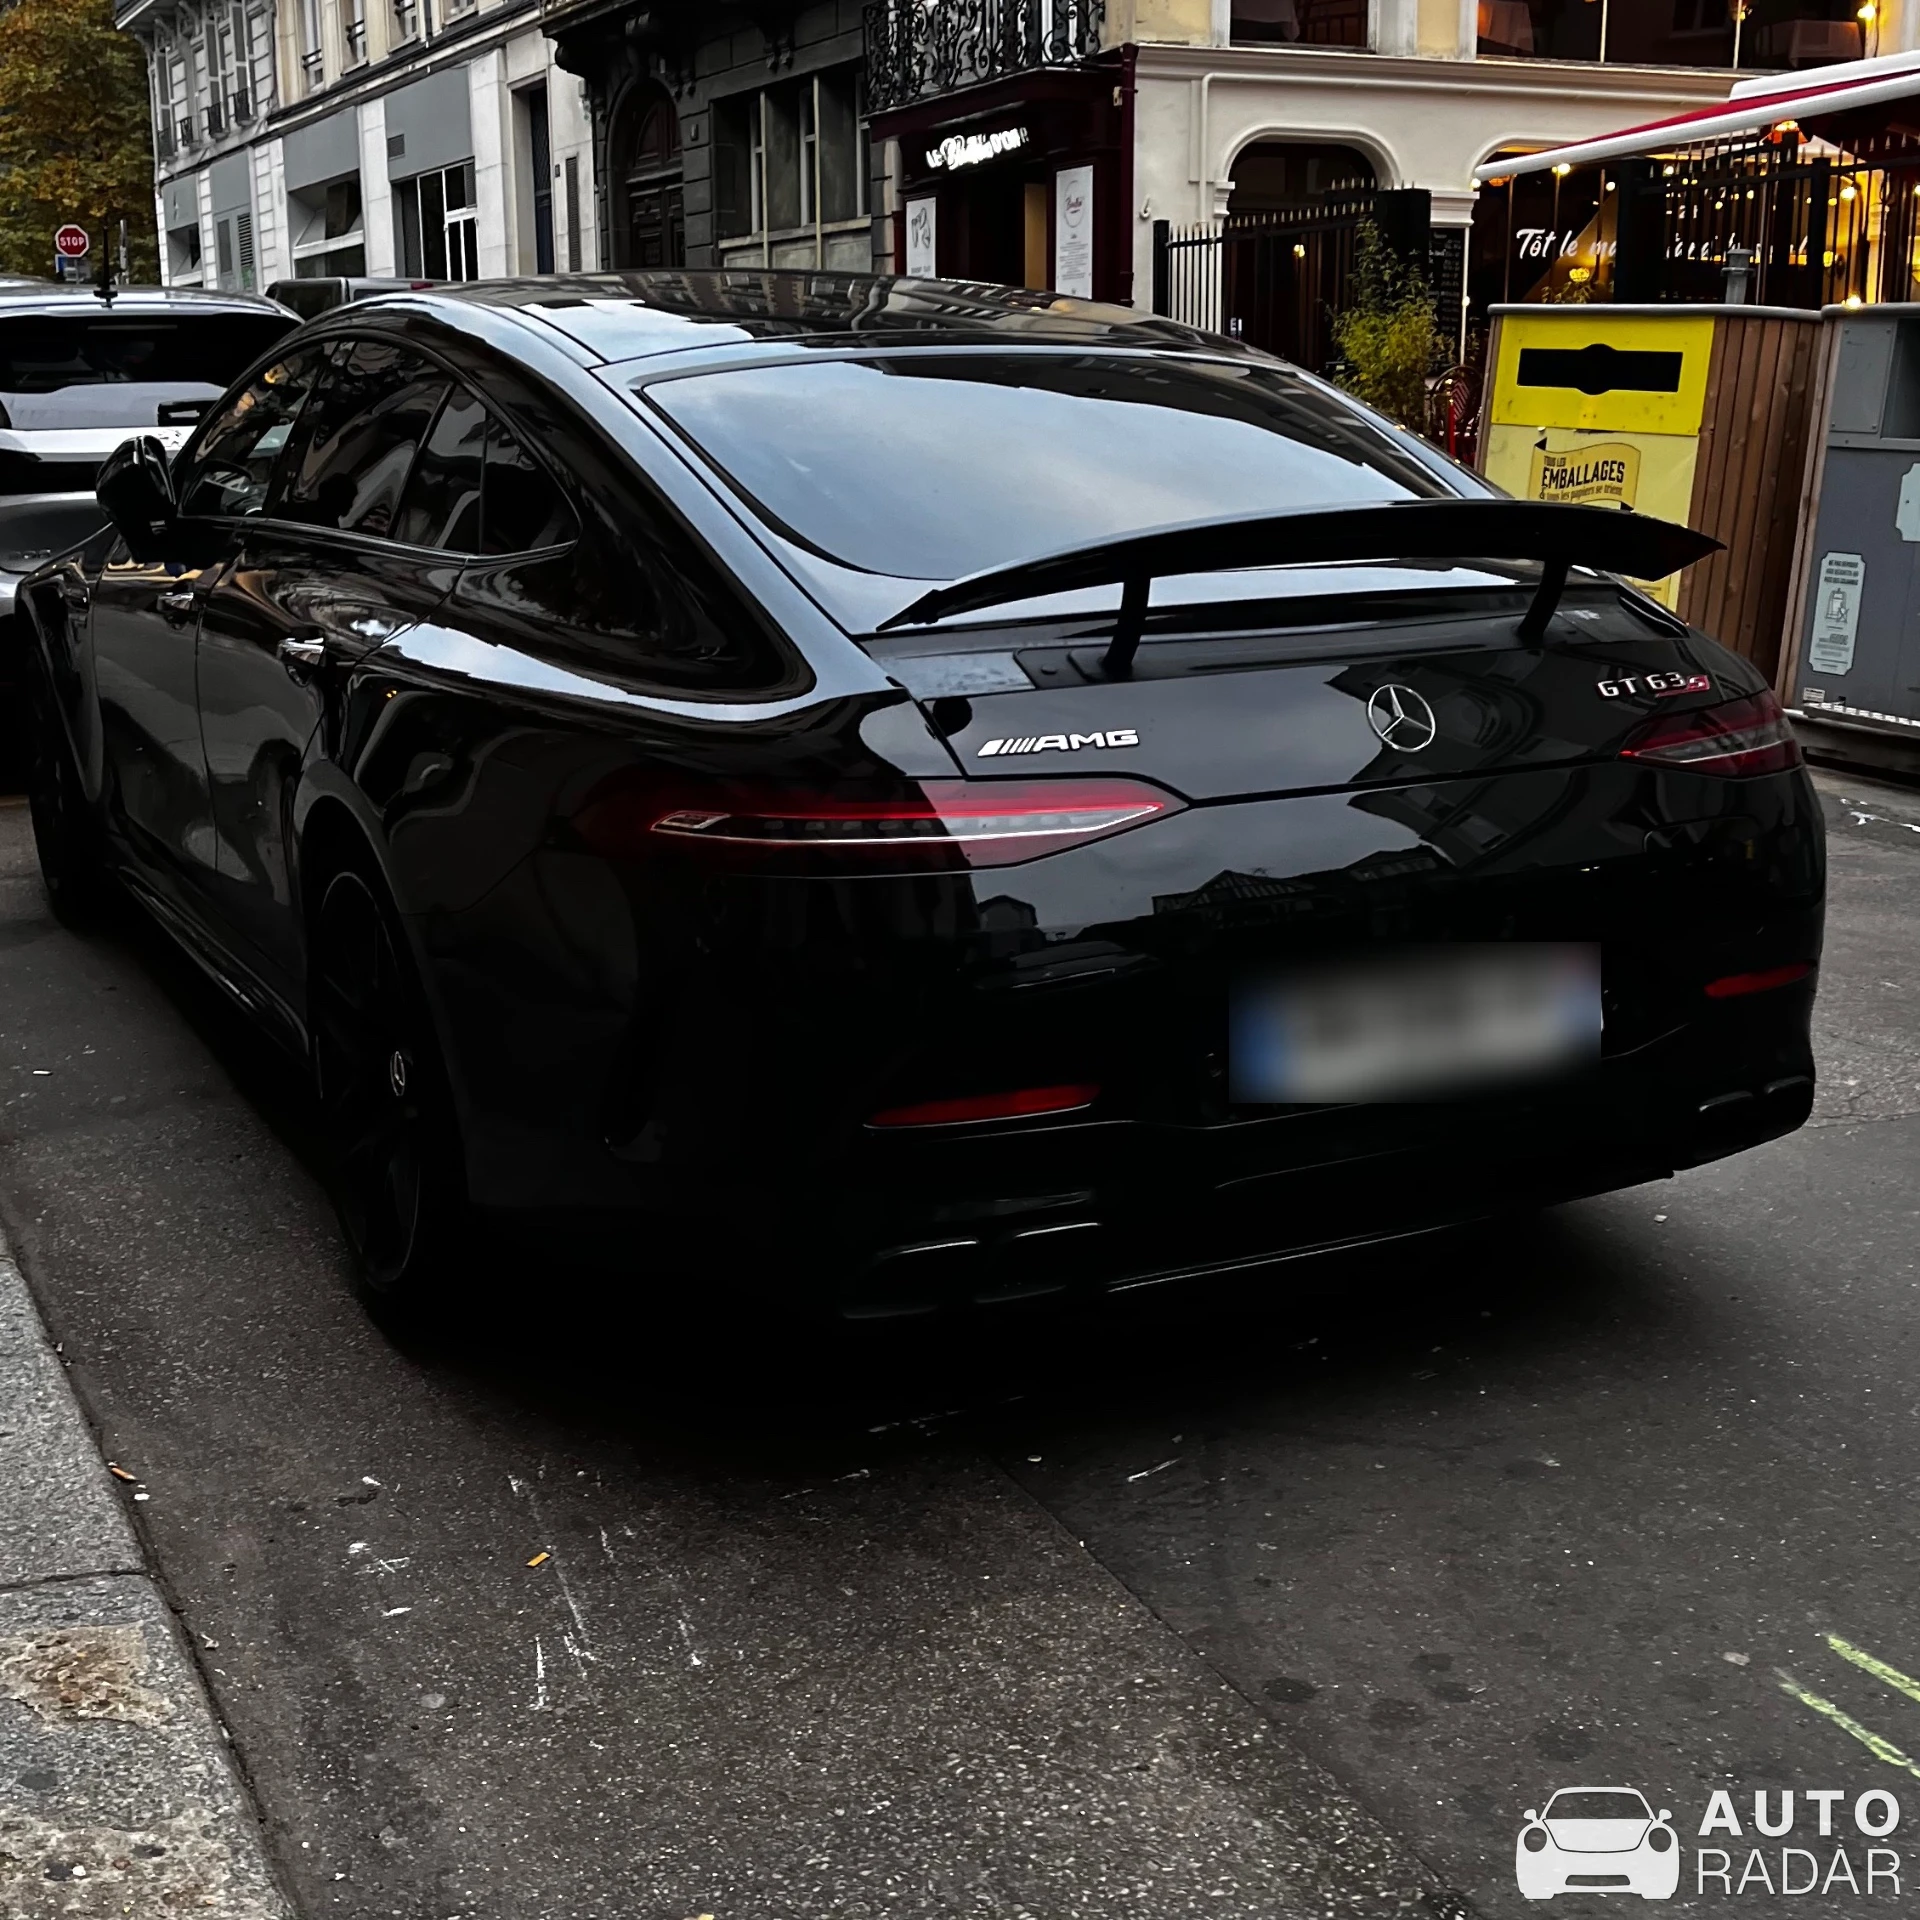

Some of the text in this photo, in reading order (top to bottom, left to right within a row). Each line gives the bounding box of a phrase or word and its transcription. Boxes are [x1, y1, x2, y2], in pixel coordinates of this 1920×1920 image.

[59, 236, 85, 247] STOP
[1516, 228, 1557, 259] Tôt
[1559, 230, 1578, 257] le
[1542, 461, 1624, 489] EMBALLAGES
[1597, 677, 1637, 697] GT
[1032, 729, 1139, 752] AMG
